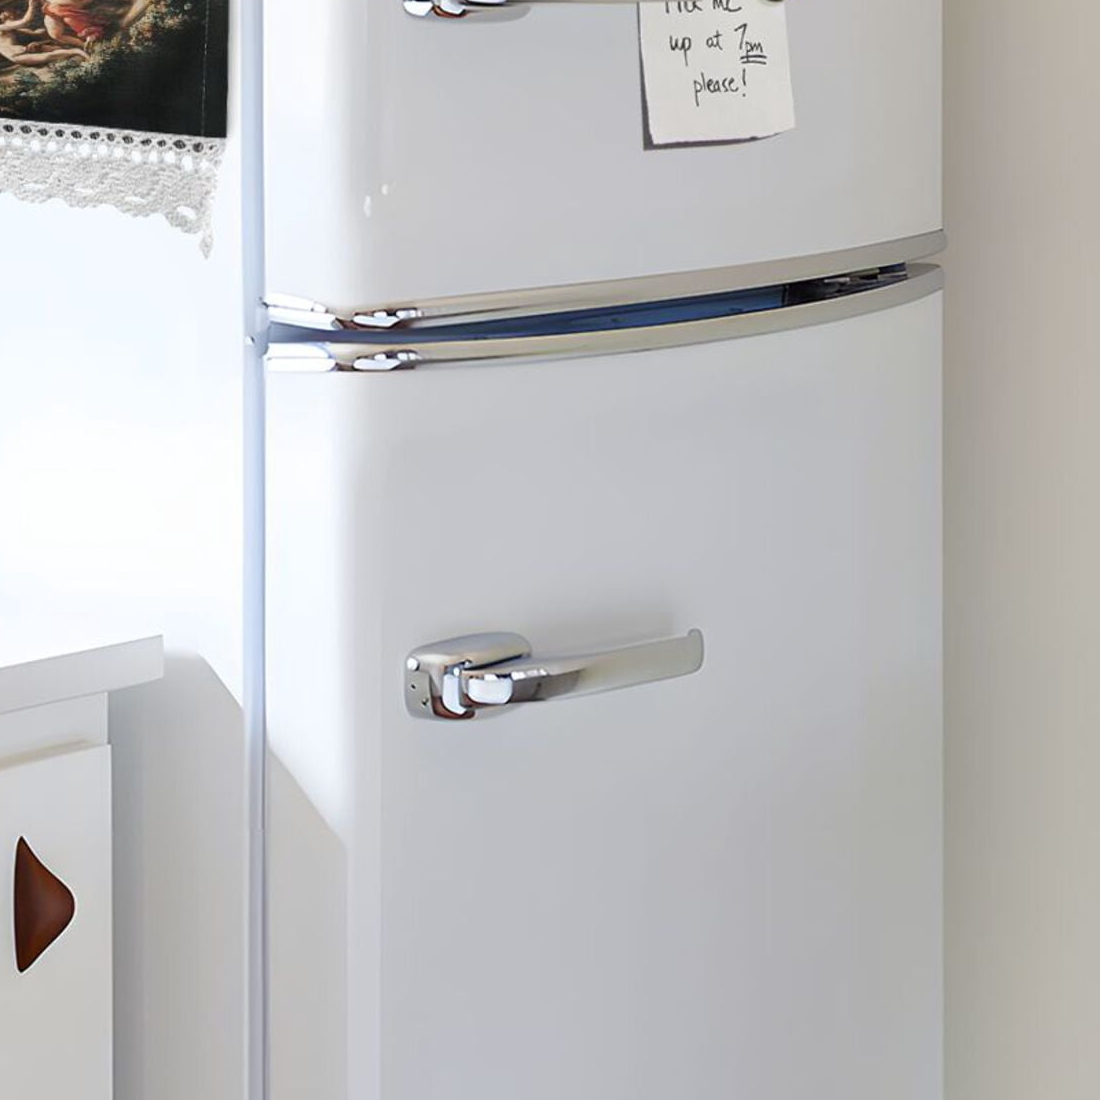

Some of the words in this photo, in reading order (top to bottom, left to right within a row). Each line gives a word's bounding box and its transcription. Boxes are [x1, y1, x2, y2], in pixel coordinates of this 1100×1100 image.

[669, 35, 692, 67] up
[705, 30, 723, 50] at
[693, 68, 747, 107] please!
